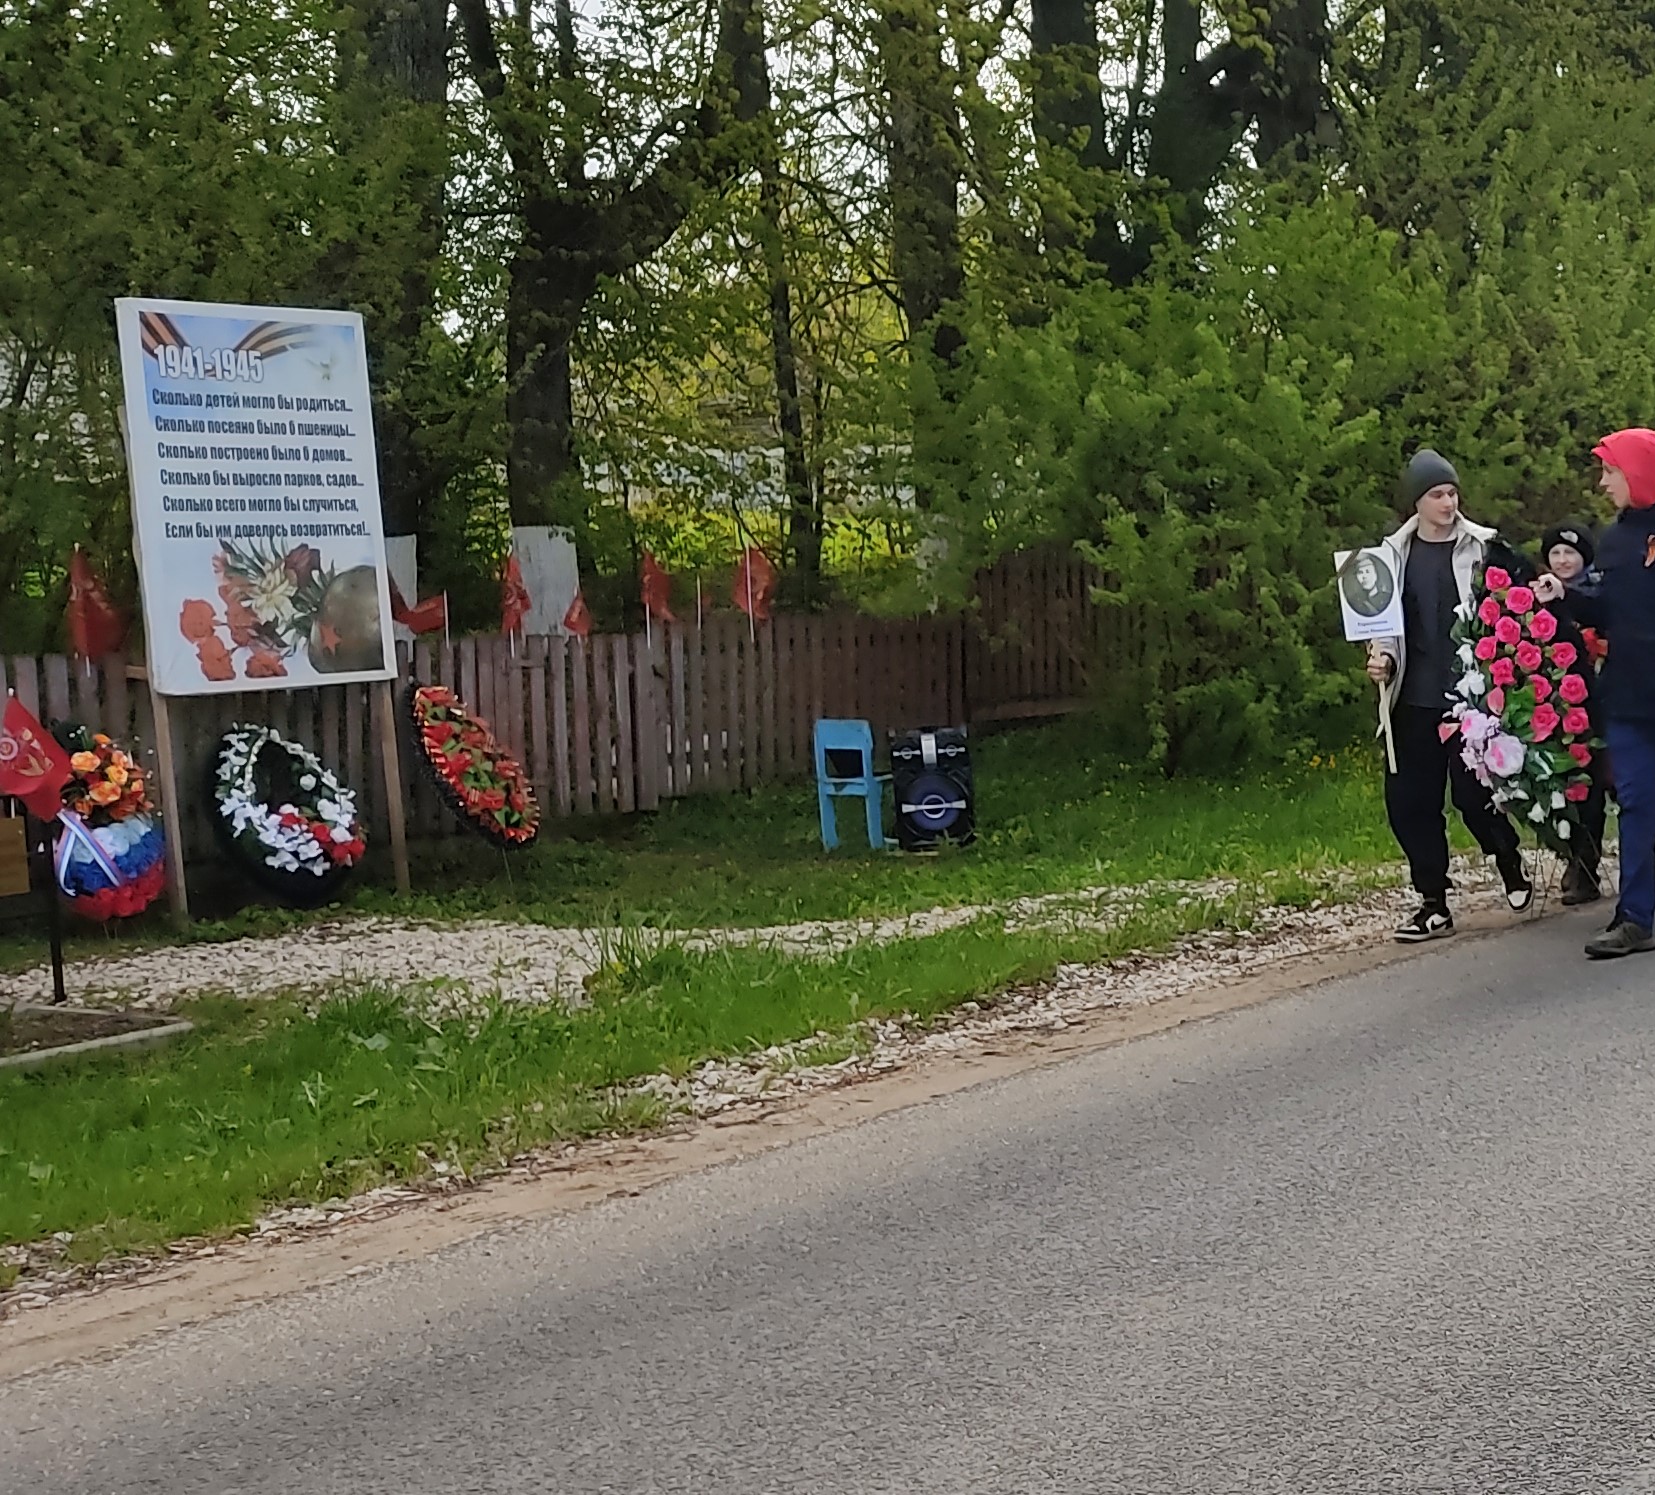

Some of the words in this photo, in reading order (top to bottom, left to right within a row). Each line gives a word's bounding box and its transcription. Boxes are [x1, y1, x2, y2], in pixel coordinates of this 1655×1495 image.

[154, 344, 264, 383] 1941-1945
[152, 388, 203, 406] Сколько
[205, 392, 240, 409] детей
[242, 395, 275, 409] могло
[277, 394, 294, 410] бы
[155, 415, 205, 433] Сколько
[207, 420, 255, 434] посеяно
[257, 419, 287, 435] было
[289, 420, 296, 436] б
[158, 442, 208, 460] Сколько
[210, 447, 269, 461] построено
[271, 445, 301, 461] было
[303, 446, 310, 461] б
[160, 469, 211, 486] Сколько
[213, 470, 230, 486] бы
[232, 473, 282, 488] выросло
[284, 473, 325, 487] парков,
[163, 495, 213, 512] Сколько
[215, 498, 246, 511] всего
[248, 498, 281, 511] могло
[283, 496, 300, 511] бы
[302, 498, 359, 513] случиться,
[165, 522, 193, 538] Если
[195, 521, 213, 538] бы
[215, 524, 231, 538] им
[235, 524, 288, 539] довелось
